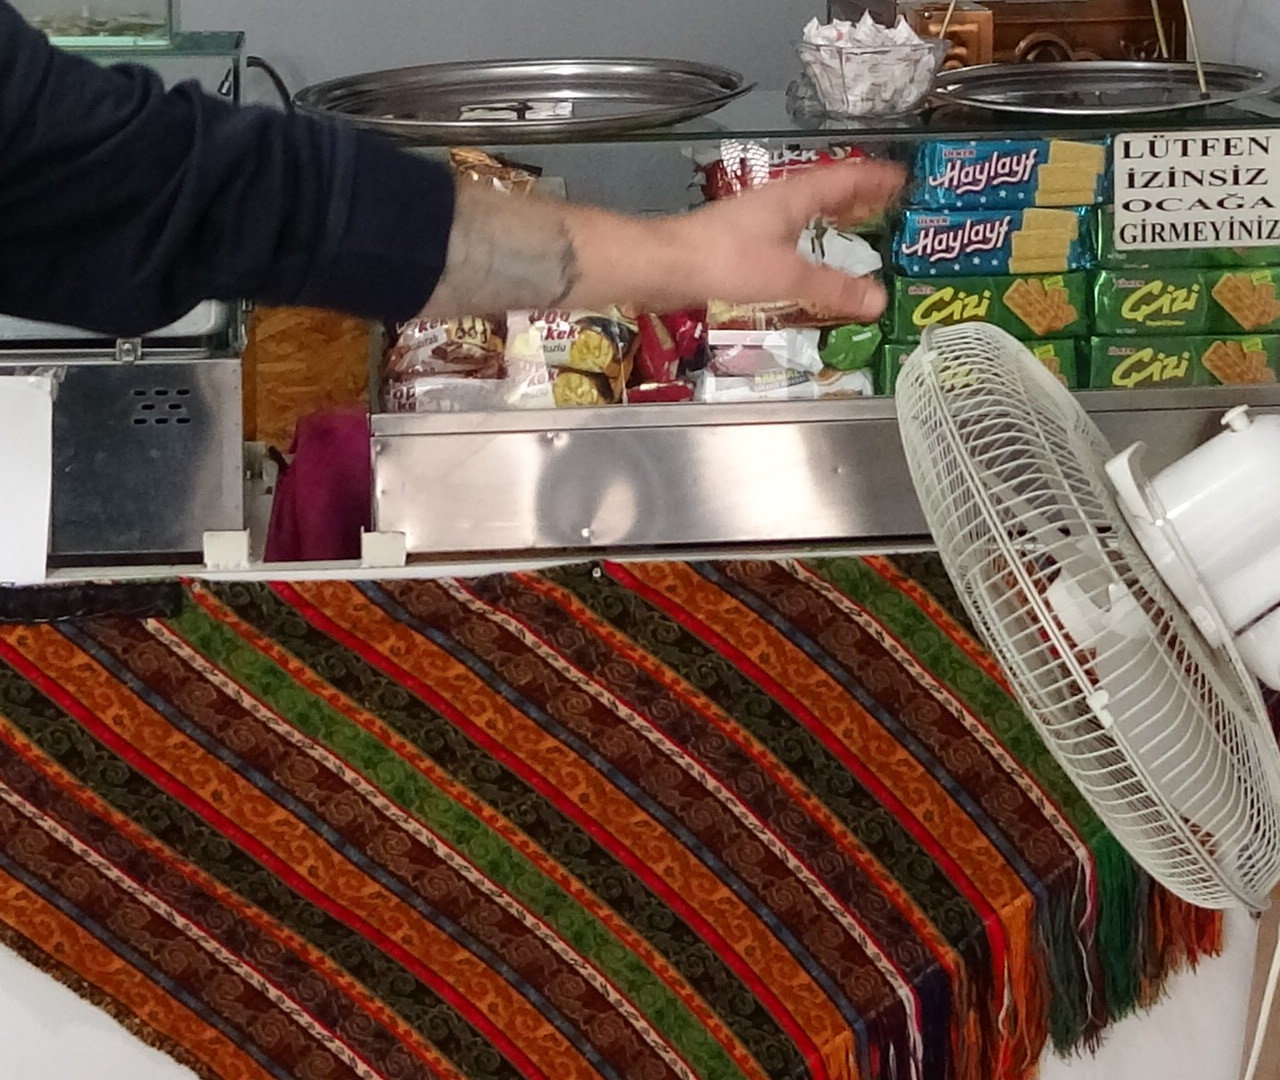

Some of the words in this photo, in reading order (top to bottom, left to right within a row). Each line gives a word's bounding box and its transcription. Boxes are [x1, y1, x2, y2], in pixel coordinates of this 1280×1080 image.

[1121, 135, 1271, 160] LÜTFEN
[928, 148, 1038, 195] Haylayf
[1125, 164, 1269, 189] İZİNSİZ
[1122, 193, 1276, 213] OCAĞA
[901, 215, 1011, 262] Haylayf
